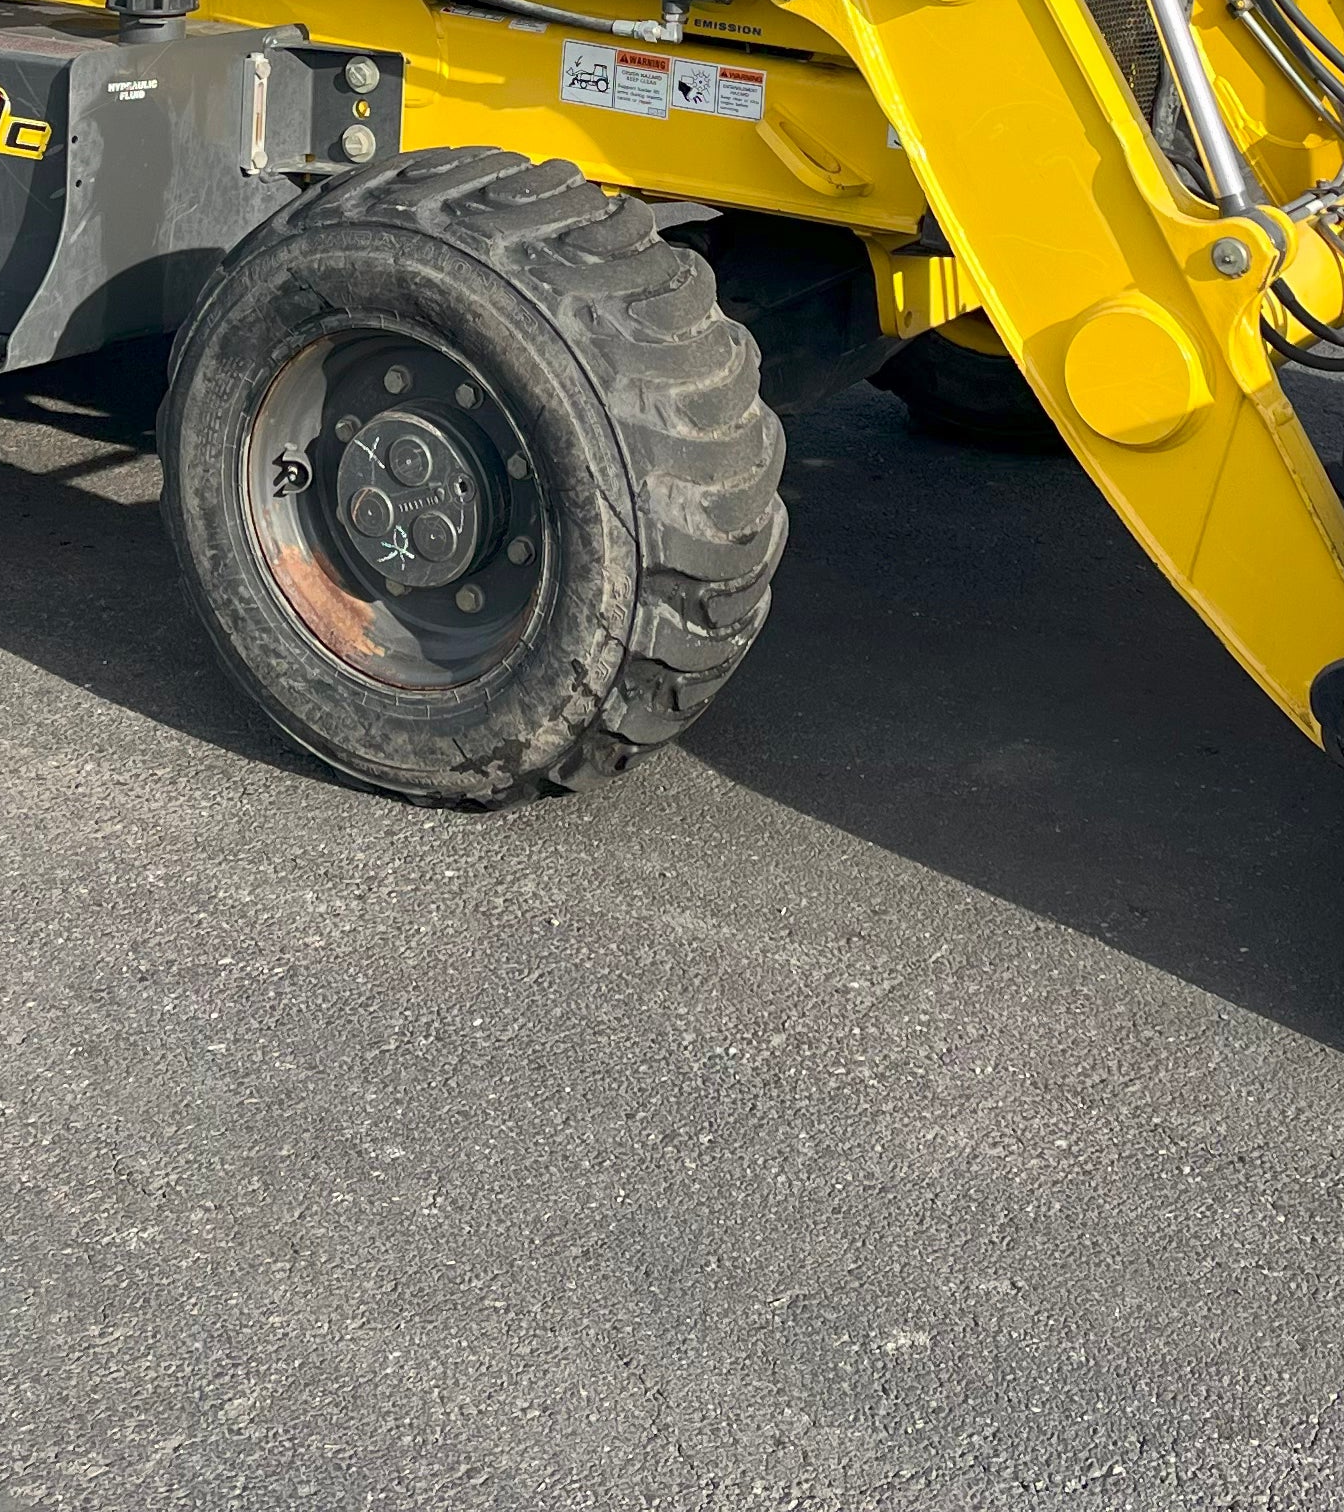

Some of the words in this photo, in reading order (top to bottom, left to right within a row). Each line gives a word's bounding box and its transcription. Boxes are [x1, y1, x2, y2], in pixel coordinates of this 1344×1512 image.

[694, 18, 763, 37] EMISSION
[630, 55, 666, 70] WARNING
[729, 72, 763, 84] WARNING
[119, 90, 146, 101] FLUID
